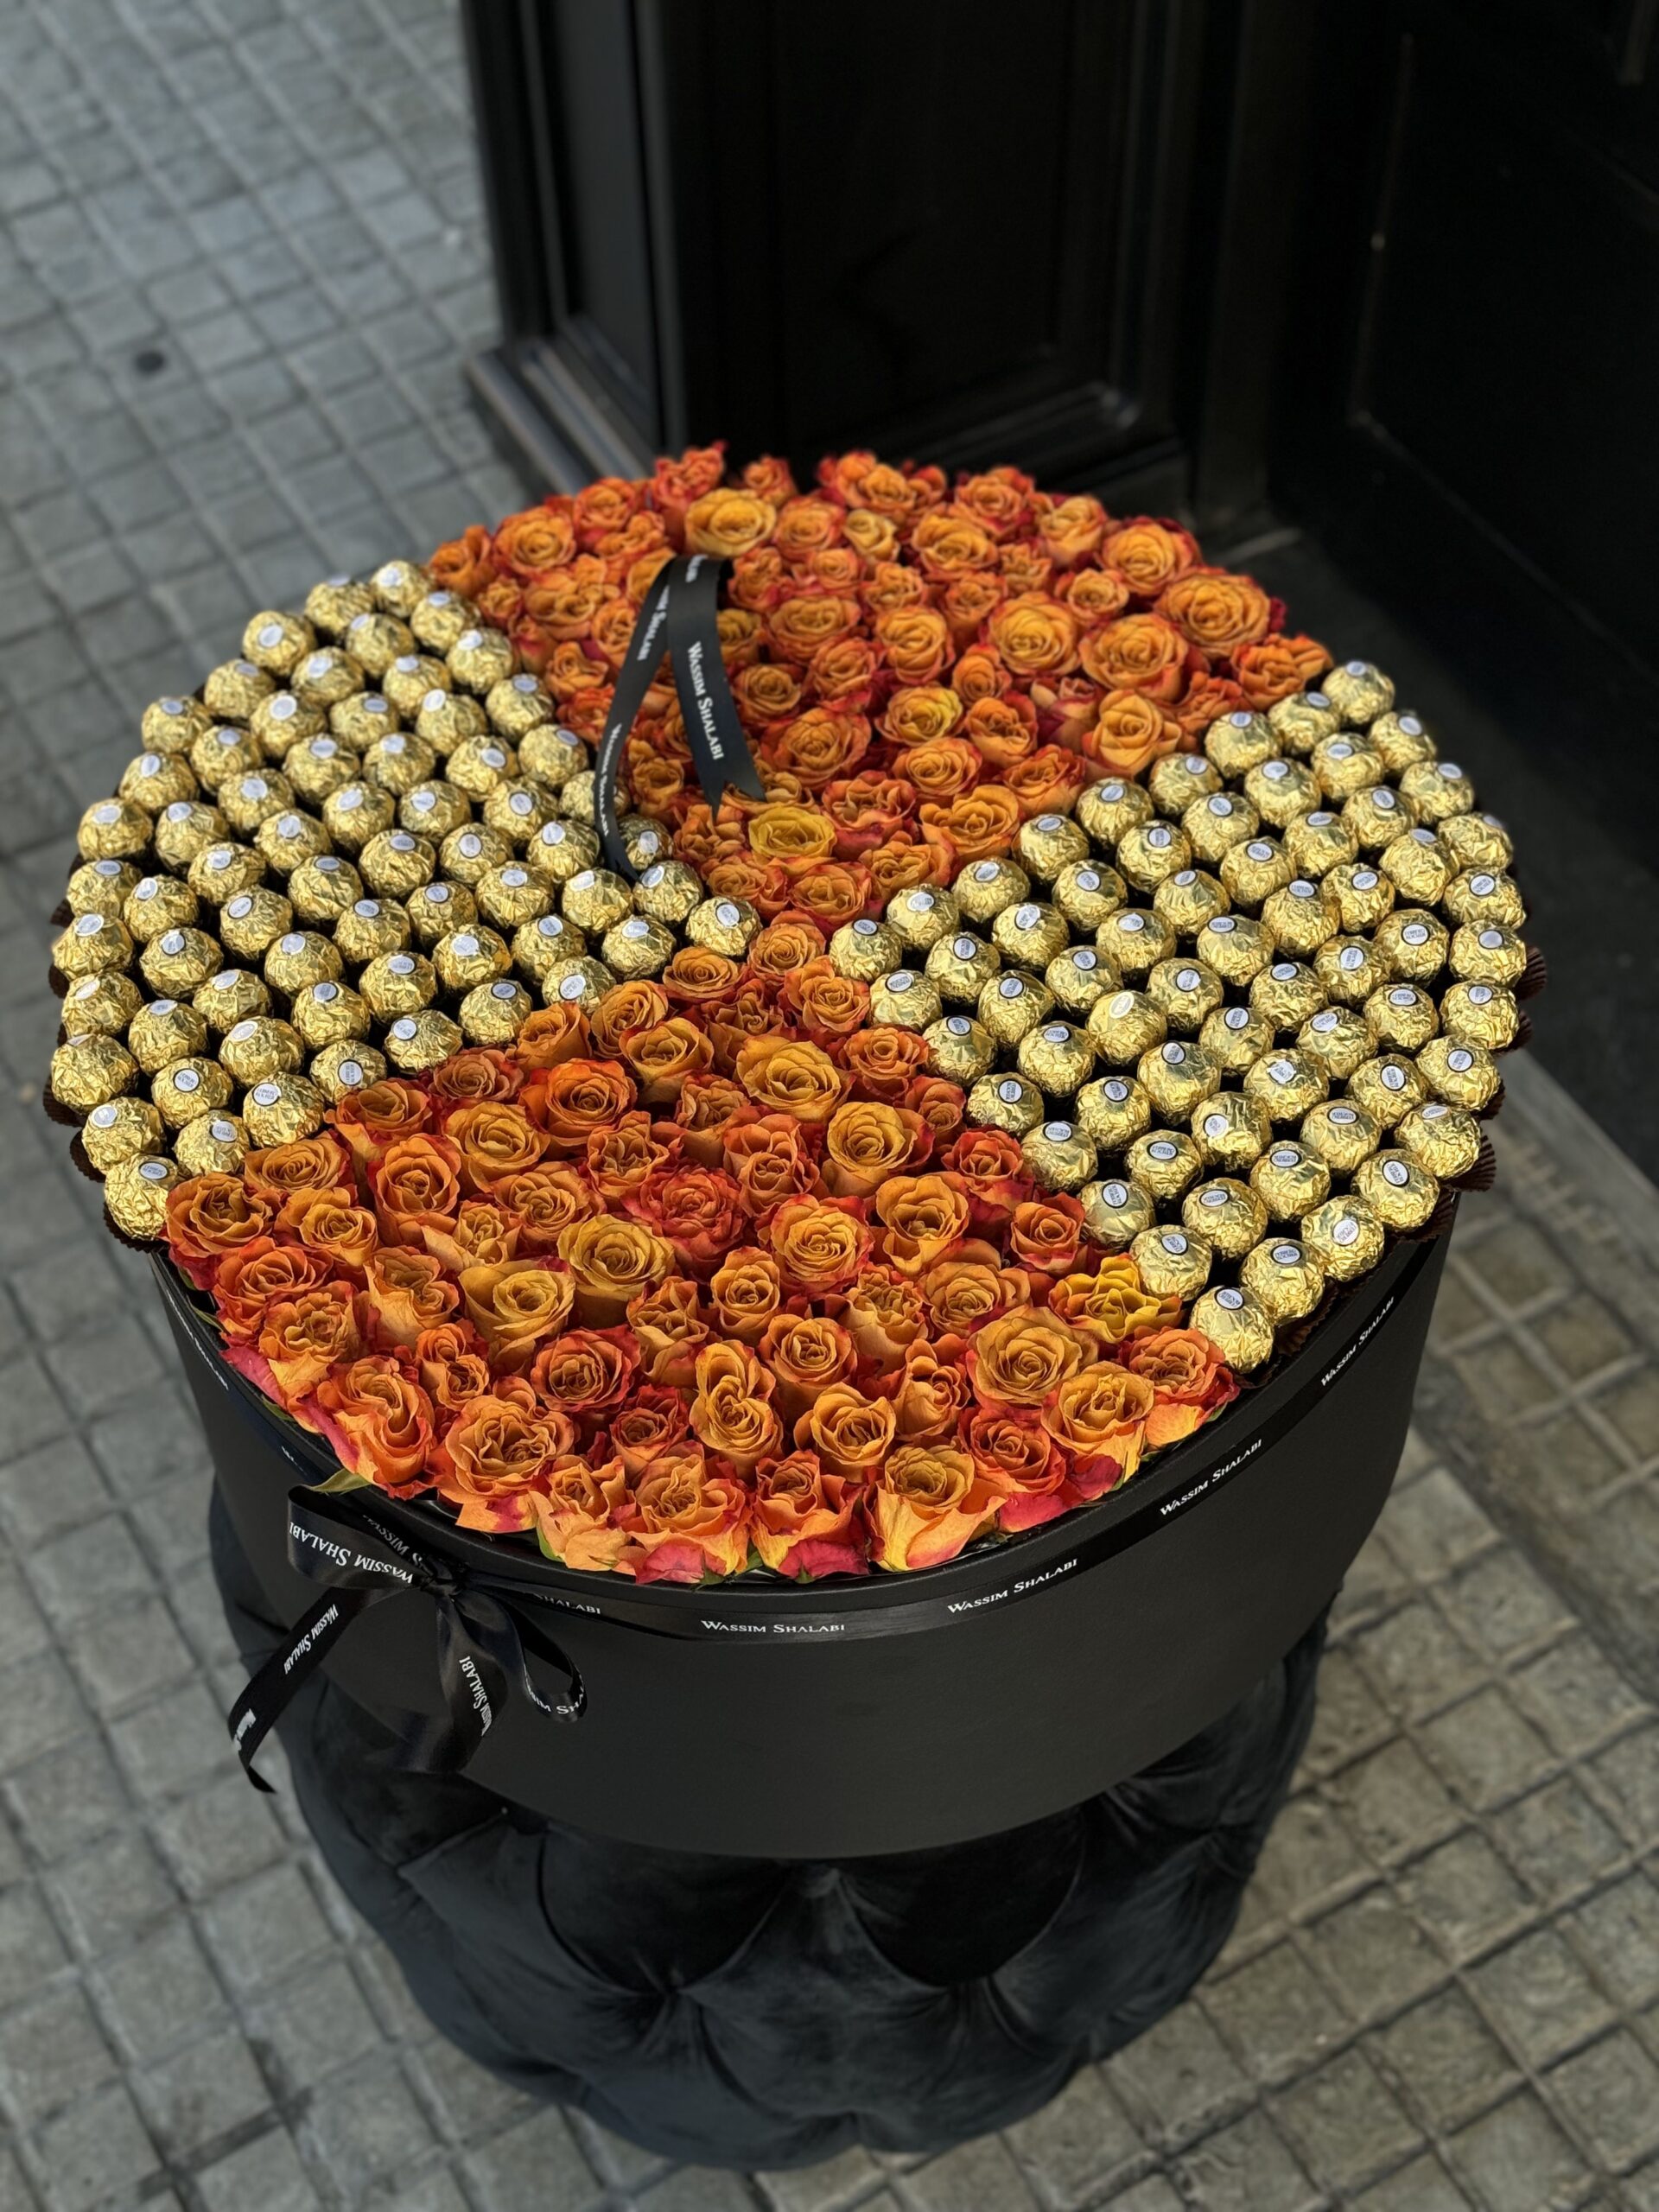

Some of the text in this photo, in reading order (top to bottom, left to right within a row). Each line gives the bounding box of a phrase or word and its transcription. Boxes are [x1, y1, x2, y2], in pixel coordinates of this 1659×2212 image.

[697, 696, 724, 760] SHALABI
[1160, 1438, 1262, 1516] WASSIM SHALABI
[289, 1521, 352, 1567] SHALABI
[353, 1554, 414, 1584] WASSIM
[947, 1558, 1078, 1614] WASSIM SHALABI
[700, 1619, 846, 1634] WASSIM SHALABI
[458, 1655, 488, 1710] SHALABI
